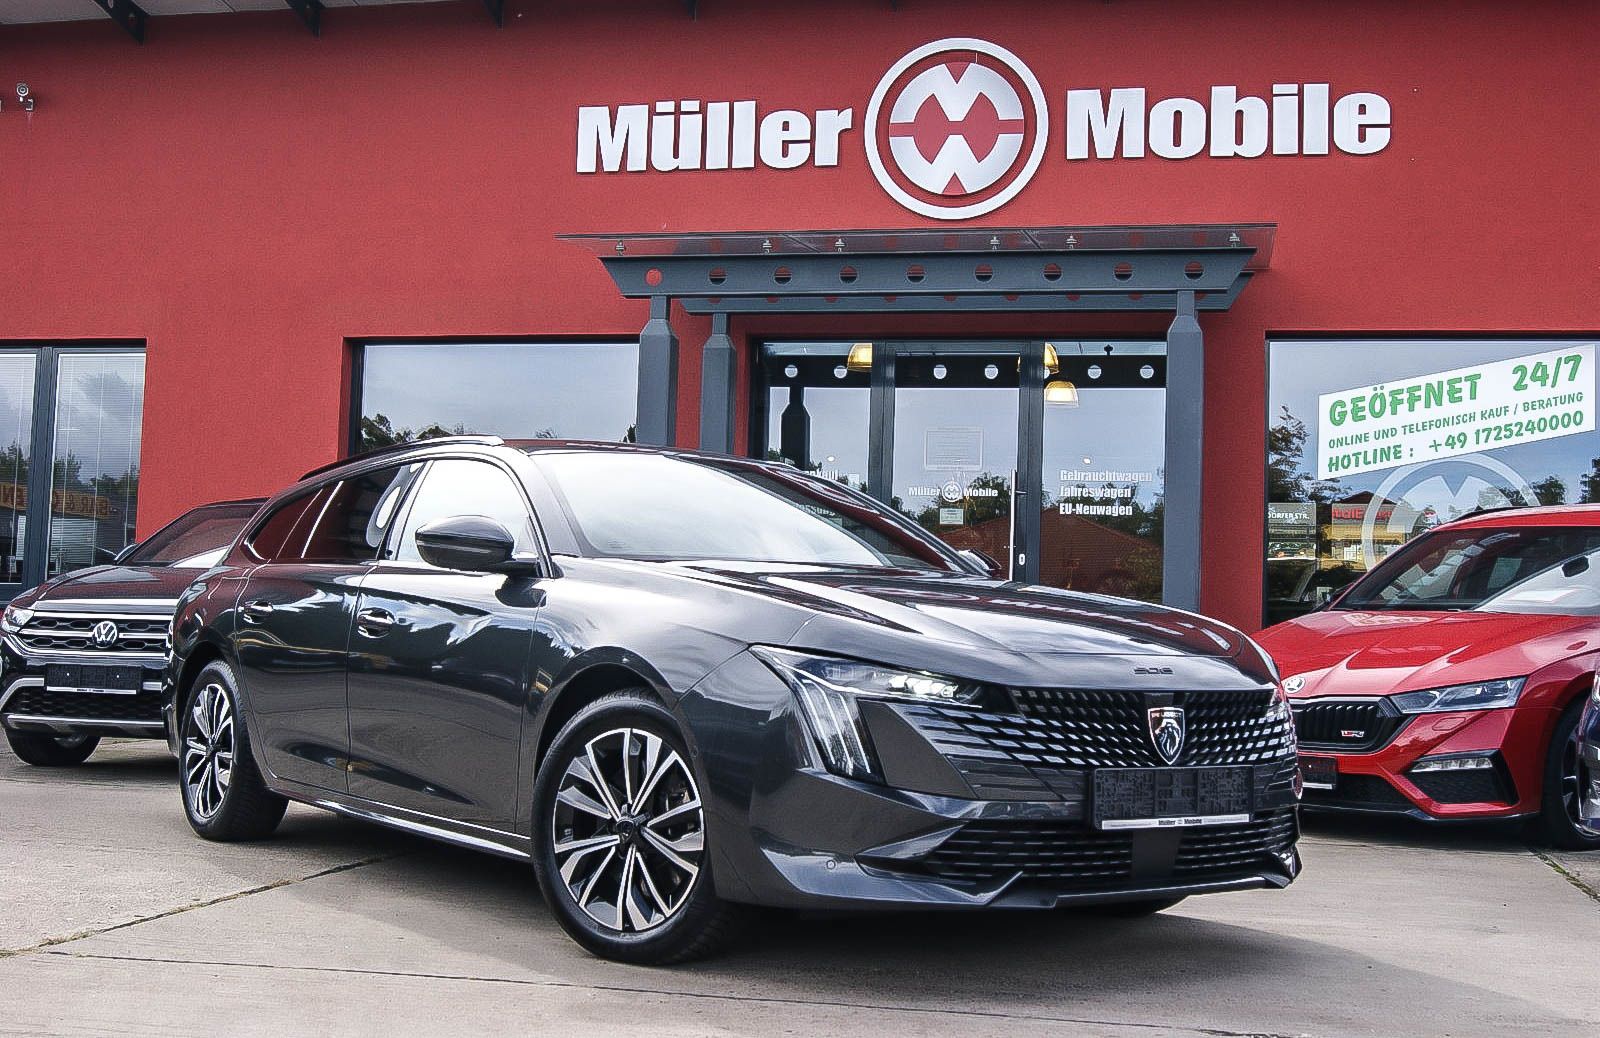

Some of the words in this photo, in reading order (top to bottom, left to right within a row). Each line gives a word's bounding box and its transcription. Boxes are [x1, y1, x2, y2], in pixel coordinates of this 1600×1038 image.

[577, 99, 852, 173] Müller
[1066, 83, 1391, 161] Mobile
[1328, 432, 1370, 449] ONLINE
[1374, 427, 1398, 440] UND
[1402, 412, 1476, 436] TELEFONISCH
[1480, 405, 1510, 420] KAUF
[1523, 391, 1584, 412] BERATUNG
[1329, 373, 1482, 427] GEÖFFNET
[1511, 354, 1582, 391] 24/7
[1328, 444, 1402, 473] HOTLINE
[1429, 432, 1467, 453] +49
[1474, 410, 1584, 445] 1725240000
[908, 486, 940, 496] Müller
[964, 487, 999, 497] Mobile
[1059, 503, 1133, 517] EU-Neuwagen
